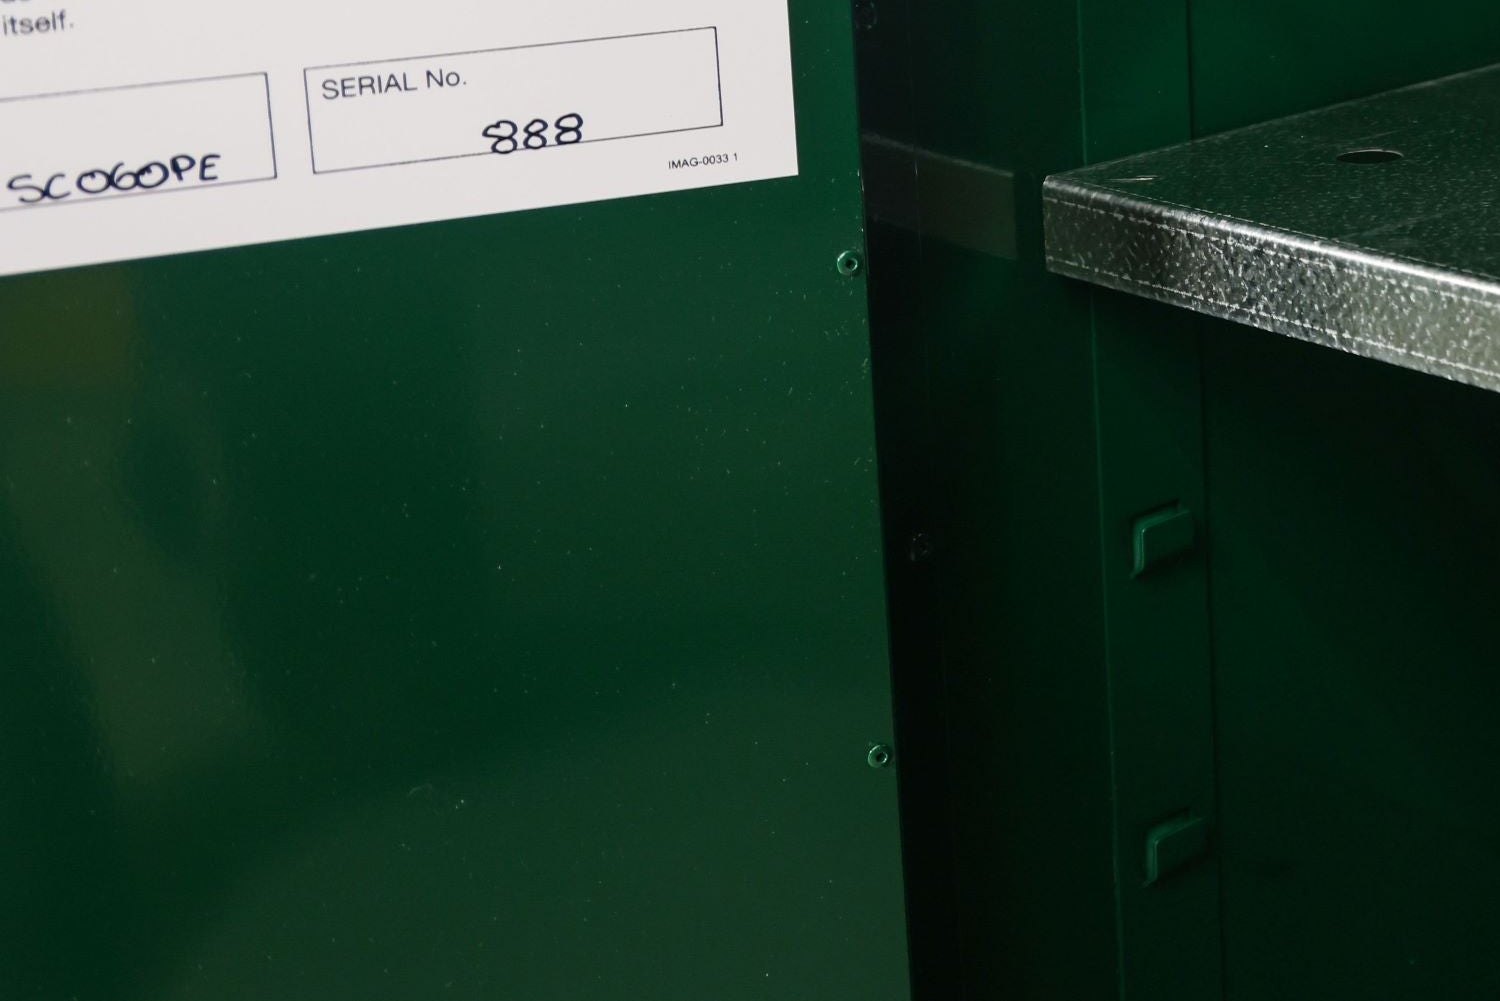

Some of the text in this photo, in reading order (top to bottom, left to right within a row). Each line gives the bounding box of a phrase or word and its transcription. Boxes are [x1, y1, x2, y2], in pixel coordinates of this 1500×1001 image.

[3, 8, 73, 37] itself.
[322, 67, 466, 101] SERIAL No.
[482, 112, 584, 154] 888
